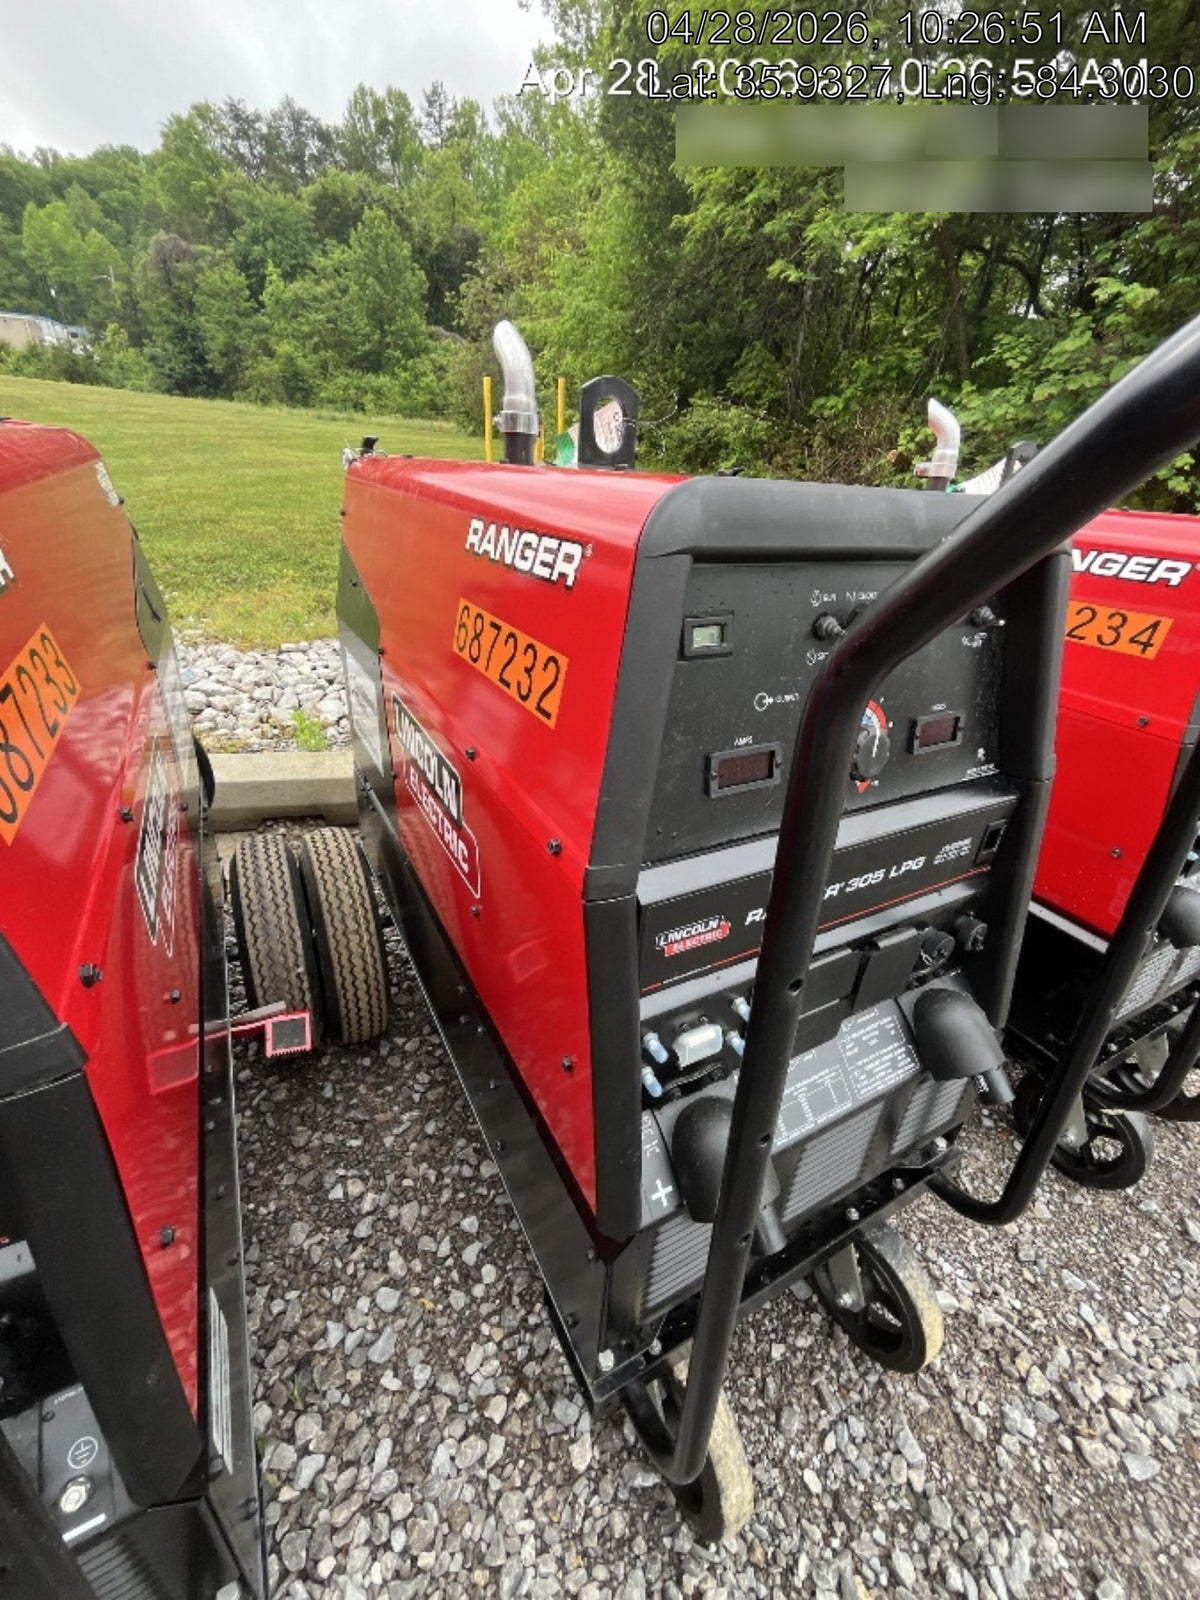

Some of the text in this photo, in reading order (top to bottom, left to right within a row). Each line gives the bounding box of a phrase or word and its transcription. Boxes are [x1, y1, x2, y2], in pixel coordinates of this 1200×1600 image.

[464, 517, 584, 590] RANGER
[1072, 548, 1192, 587] NGER
[1066, 605, 1163, 655] 234
[456, 604, 562, 721] 687232
[392, 697, 460, 821] LINCOLN
[408, 766, 469, 874] ELECTRIC
[844, 868, 887, 893] 305
[888, 855, 927, 880] LPG
[659, 917, 720, 947] LINCOLN
